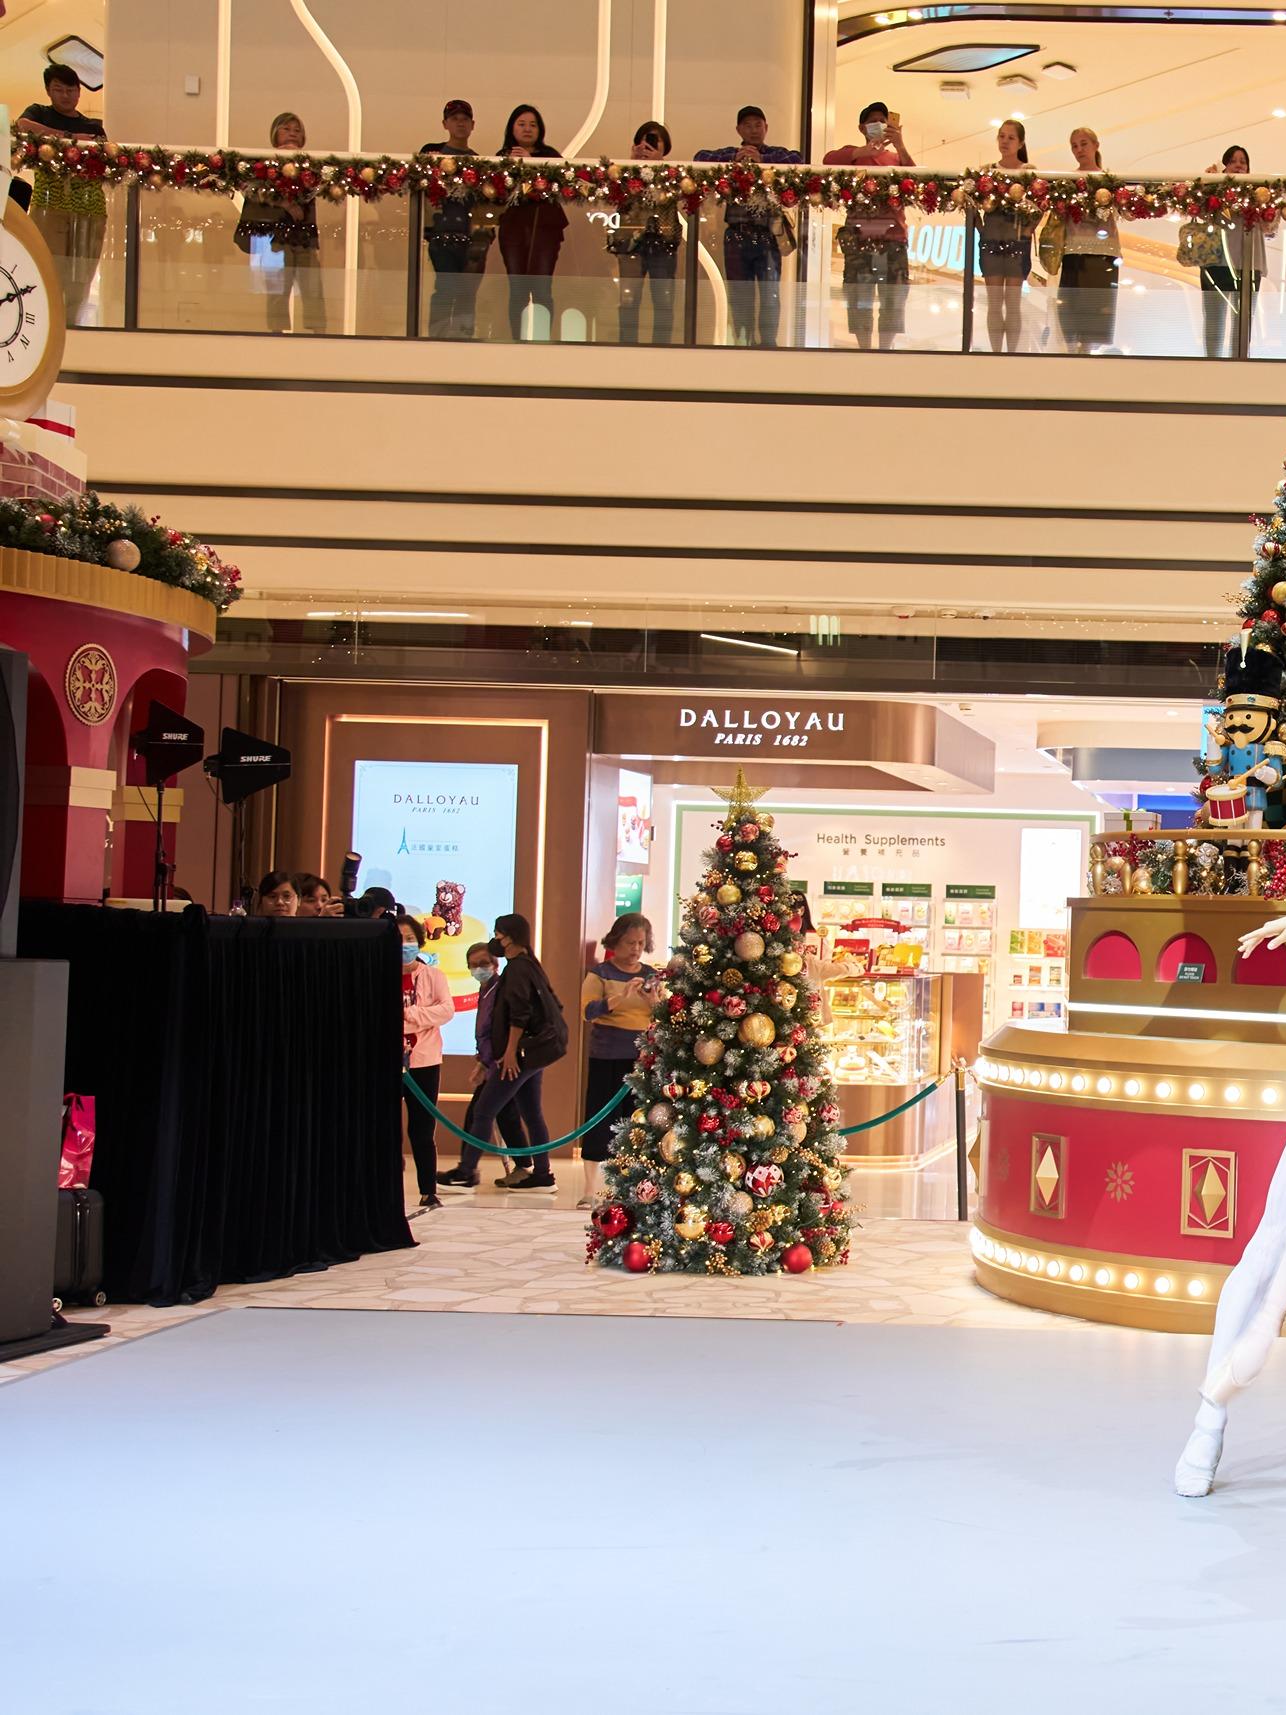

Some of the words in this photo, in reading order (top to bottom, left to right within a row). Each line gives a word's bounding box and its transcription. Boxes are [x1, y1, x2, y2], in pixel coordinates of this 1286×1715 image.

[679, 708, 844, 731] DALLOYAU
[162, 733, 189, 741] SHURE
[714, 733, 763, 745] PARIS
[773, 734, 809, 747] 1682
[240, 755, 272, 763] SHURE
[393, 793, 479, 805] DALLOYAU
[816, 833, 857, 845] Health
[864, 834, 946, 847] Supplements
